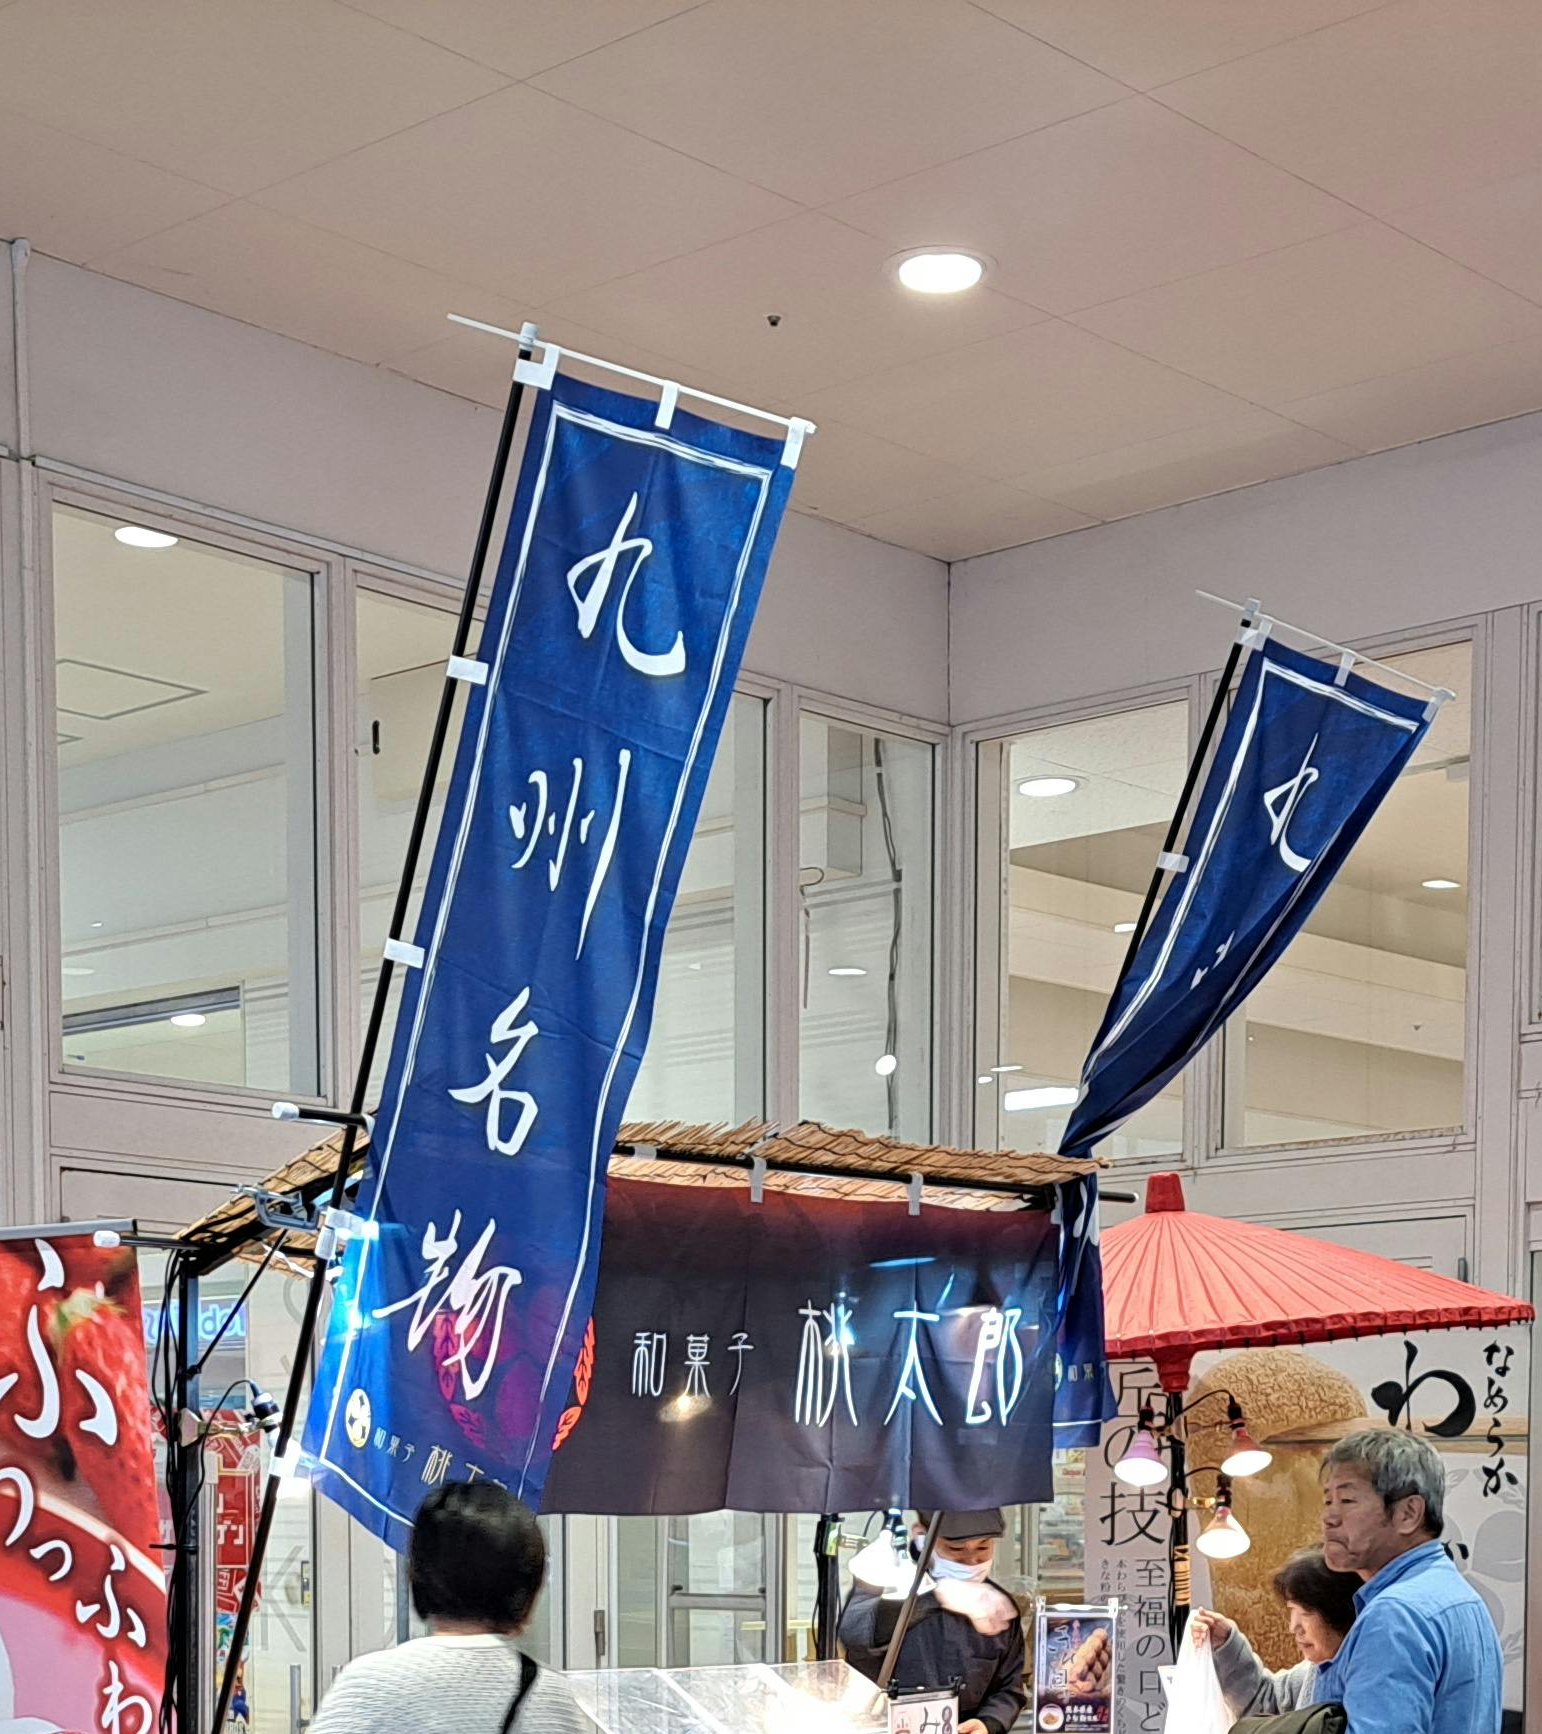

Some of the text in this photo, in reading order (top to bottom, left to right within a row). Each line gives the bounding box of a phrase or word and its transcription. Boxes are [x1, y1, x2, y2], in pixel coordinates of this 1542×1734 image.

[373, 491, 687, 1401] 九州名物
[631, 1299, 1023, 1427] 和菓子 桃太郎
[1482, 1338, 1519, 1498] なめらか
